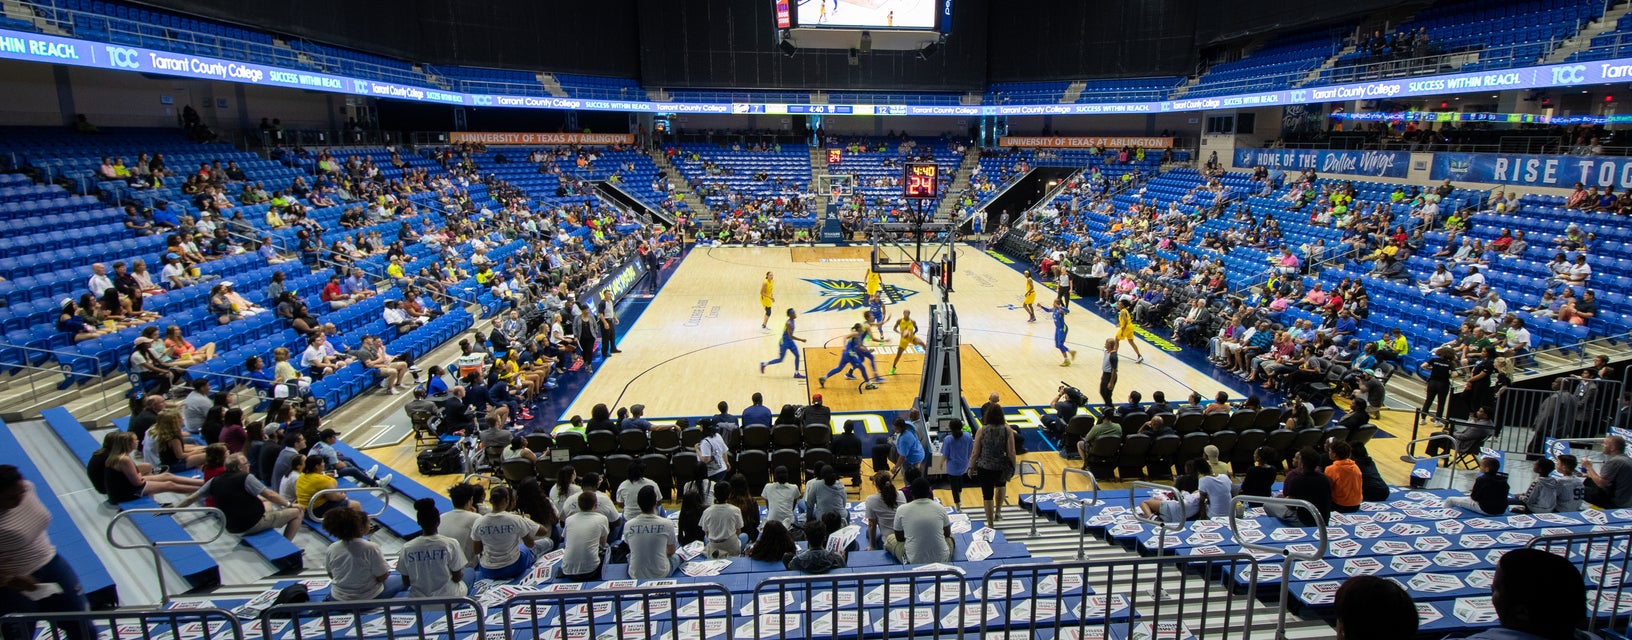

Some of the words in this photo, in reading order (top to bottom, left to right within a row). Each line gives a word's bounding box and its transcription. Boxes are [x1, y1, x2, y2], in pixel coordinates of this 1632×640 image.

[29, 40, 79, 59] REACH.
[106, 46, 140, 68] TCC
[150, 53, 189, 72] Tarrant
[191, 58, 227, 78] County
[228, 64, 263, 82] College
[270, 70, 298, 84] SUCCESS
[299, 75, 323, 87] WITHIN
[1552, 65, 1586, 84] TCC
[1409, 80, 1444, 92] SUCCESS
[1447, 76, 1481, 89] WITHIN
[1484, 73, 1520, 85] REACH.
[1312, 88, 1336, 99] Tarrant
[1337, 84, 1366, 98] County
[1366, 80, 1400, 95] College
[472, 95, 492, 105] TCC
[497, 97, 523, 105] Tarrant
[525, 98, 551, 107] County
[553, 99, 580, 109] College
[1291, 91, 1306, 102] TCC
[679, 104, 701, 112] County
[1000, 106, 1021, 114] Tarrant
[1022, 106, 1044, 115] County
[1046, 105, 1070, 114] College
[462, 134, 522, 142] UNIVERSITY
[524, 134, 534, 142] OF
[537, 134, 565, 142] TEXAS
[581, 135, 626, 143] ARLINGTON
[1007, 138, 1054, 146] UNIVERSITY
[1056, 138, 1066, 146] OF
[1068, 138, 1094, 146] TEXAS
[1097, 138, 1107, 146] AT
[1110, 138, 1162, 147] ARLINGTON
[830, 154, 840, 162] 24
[1257, 153, 1280, 165] HOME
[1284, 154, 1294, 166] OF
[1299, 154, 1317, 168] THE
[1323, 153, 1356, 172] Dallas
[1360, 151, 1395, 177] Wings
[913, 166, 935, 176] 4:40
[1494, 158, 1559, 183] RISE
[910, 176, 932, 194] 24
[480, 525, 516, 536] STAFF
[629, 524, 664, 535] STAFF
[408, 549, 448, 563] STAFF
